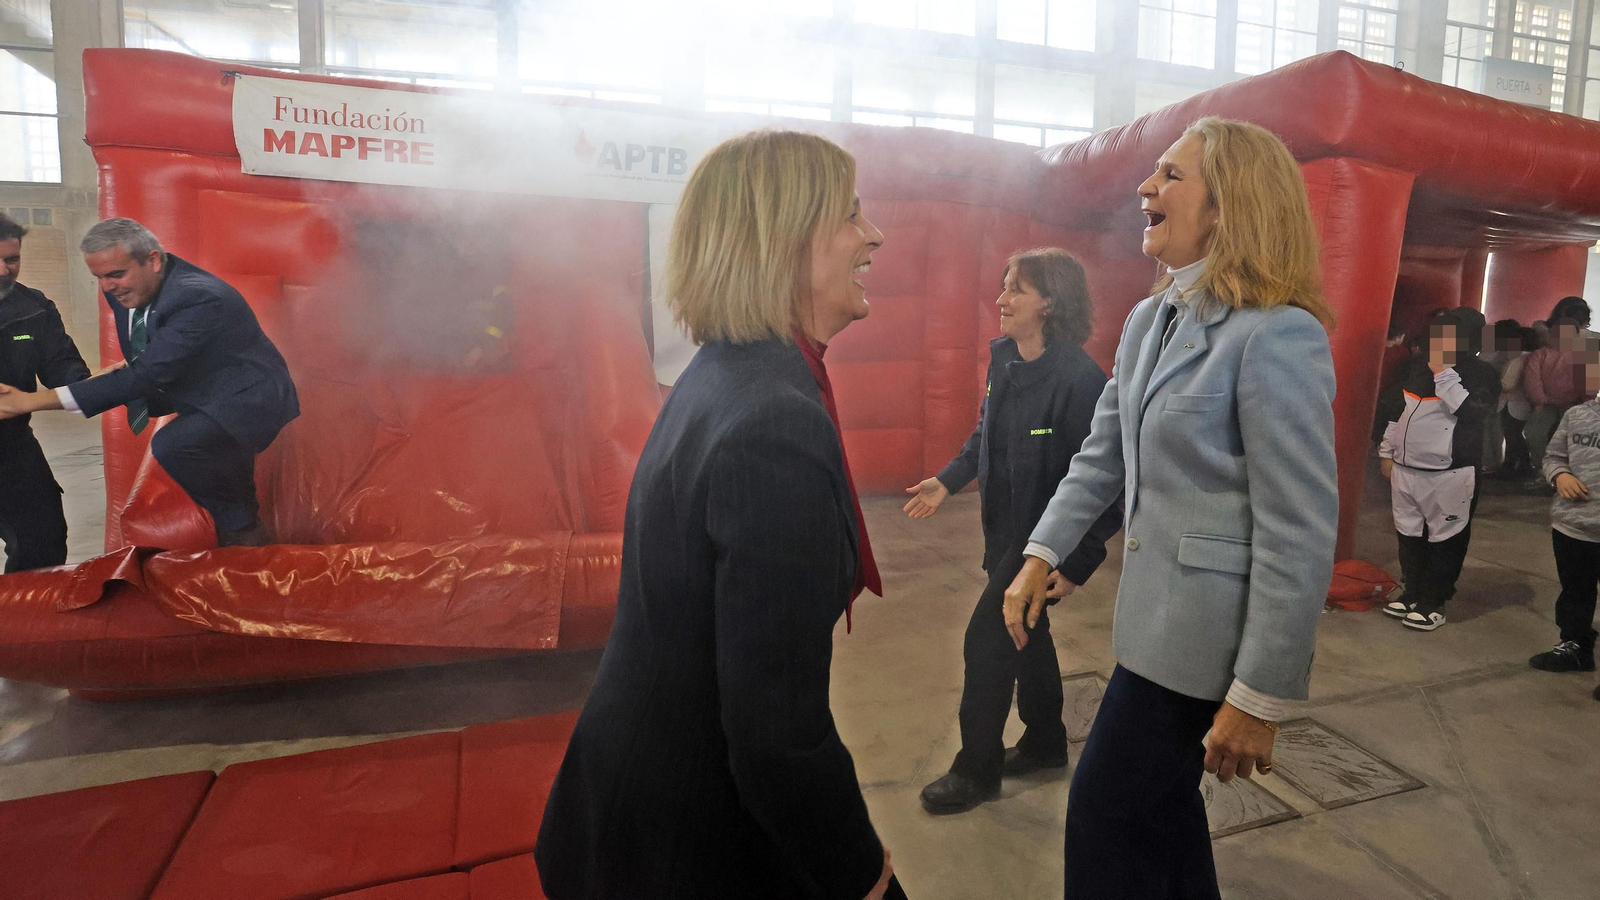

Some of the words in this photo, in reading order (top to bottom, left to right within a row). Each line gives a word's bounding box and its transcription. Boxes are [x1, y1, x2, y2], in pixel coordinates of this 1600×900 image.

[1496, 77, 1531, 94] PUERTA
[1536, 83, 1543, 96] 5
[272, 95, 426, 134] Fundación
[263, 128, 434, 166] MAPFRE
[596, 141, 688, 176] APTB
